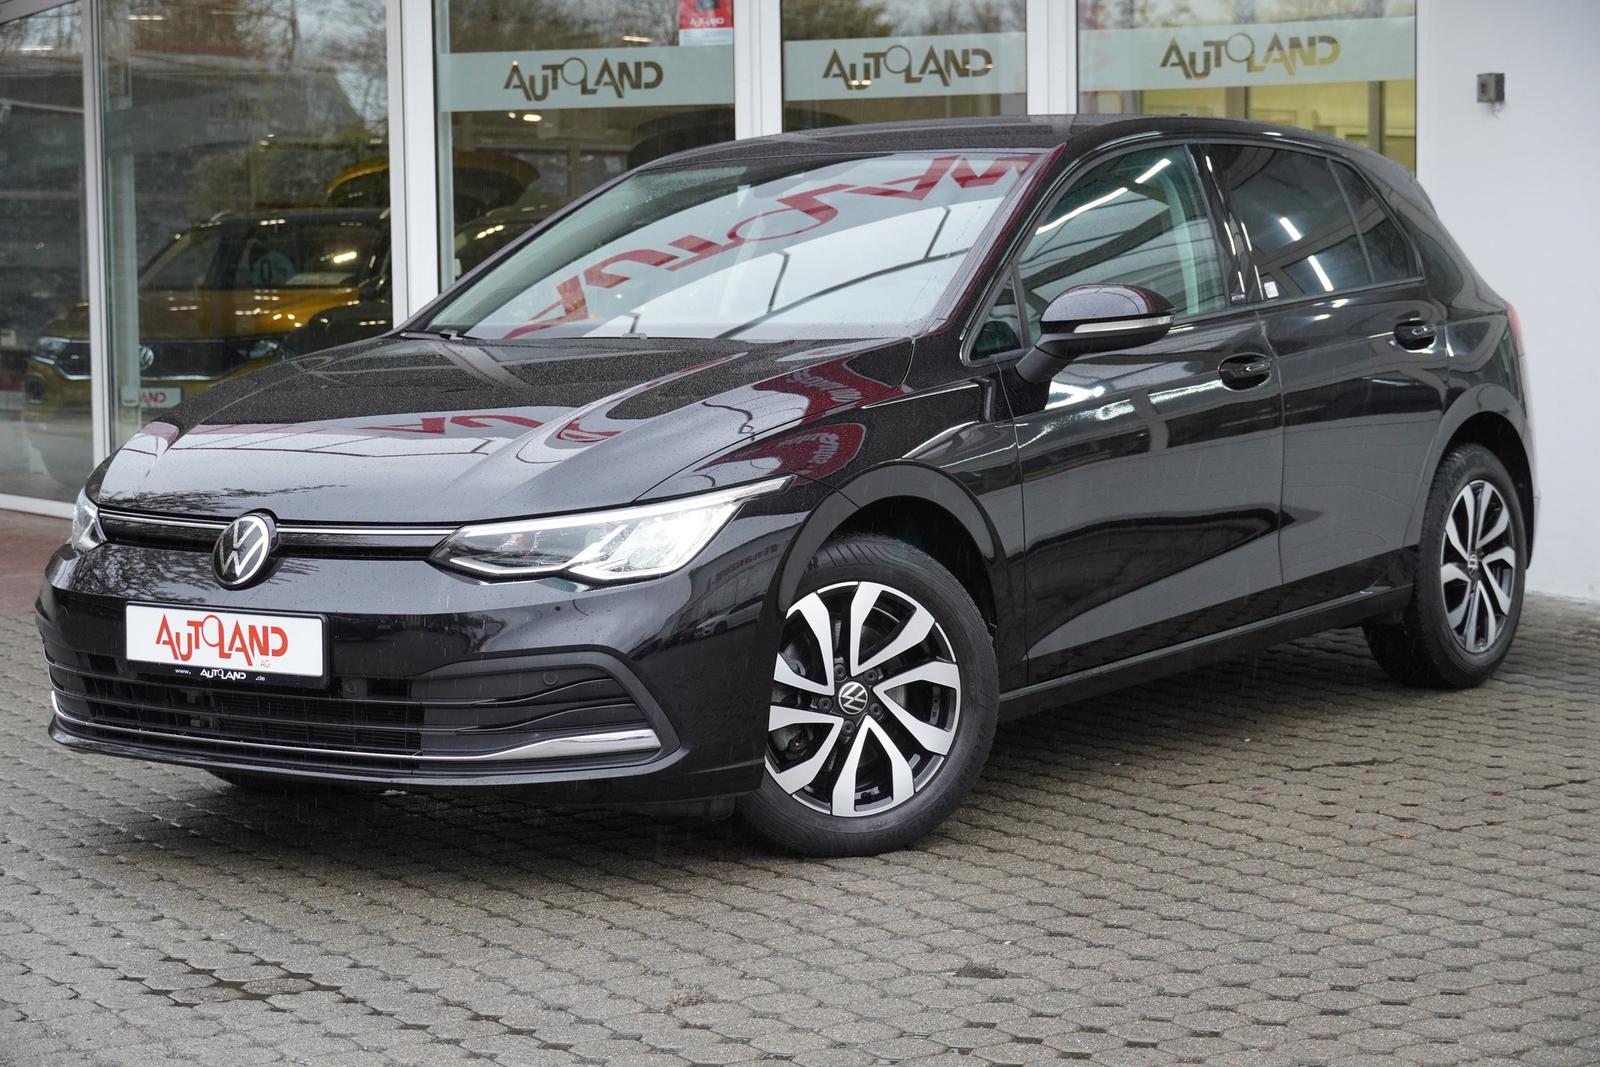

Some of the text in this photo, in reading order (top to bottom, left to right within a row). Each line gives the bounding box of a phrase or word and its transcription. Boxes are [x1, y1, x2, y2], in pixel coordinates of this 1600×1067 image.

[822, 44, 993, 91] AUTOLAND
[1159, 32, 1341, 80] AUTOLAND
[503, 57, 663, 102] AUTOLAND
[155, 613, 289, 667] AUTOLAND
[200, 668, 247, 681] AUTOLAND
[260, 660, 270, 668] AG
